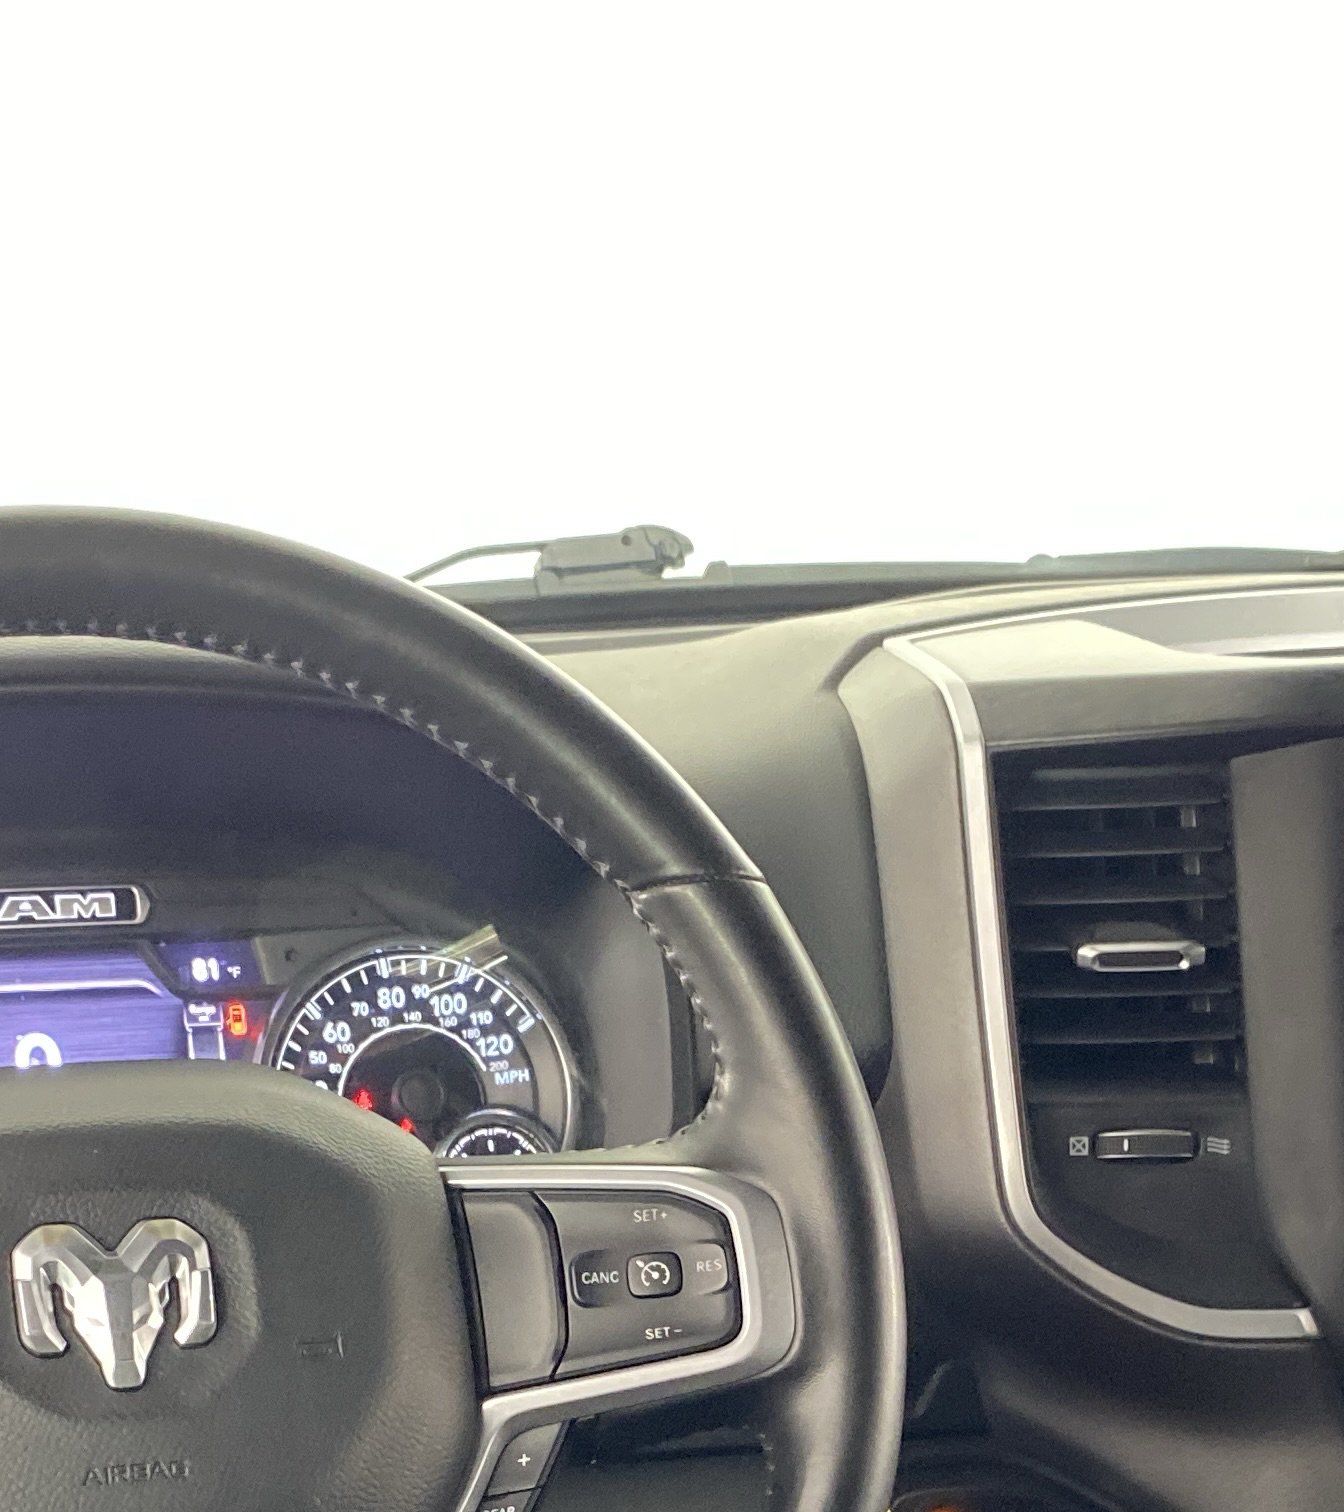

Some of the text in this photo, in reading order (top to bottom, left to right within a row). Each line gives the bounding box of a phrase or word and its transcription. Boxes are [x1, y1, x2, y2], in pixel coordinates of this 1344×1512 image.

[191, 957, 220, 982] 81
[376, 985, 406, 1010] 80
[411, 983, 430, 1000] 90
[350, 1000, 369, 1018] 70
[429, 992, 468, 1018] 100
[371, 1015, 390, 1029] 120
[403, 1010, 422, 1024] 140
[438, 1016, 458, 1028] 160
[470, 1010, 494, 1027] 110
[322, 1021, 352, 1044] 60
[335, 1042, 356, 1055] 100
[475, 1033, 515, 1058] 120
[308, 1050, 328, 1066] 50
[488, 1060, 510, 1073] 200
[493, 1068, 531, 1086] MPH
[696, 1259, 723, 1274] RES
[581, 1270, 620, 1285] CANC
